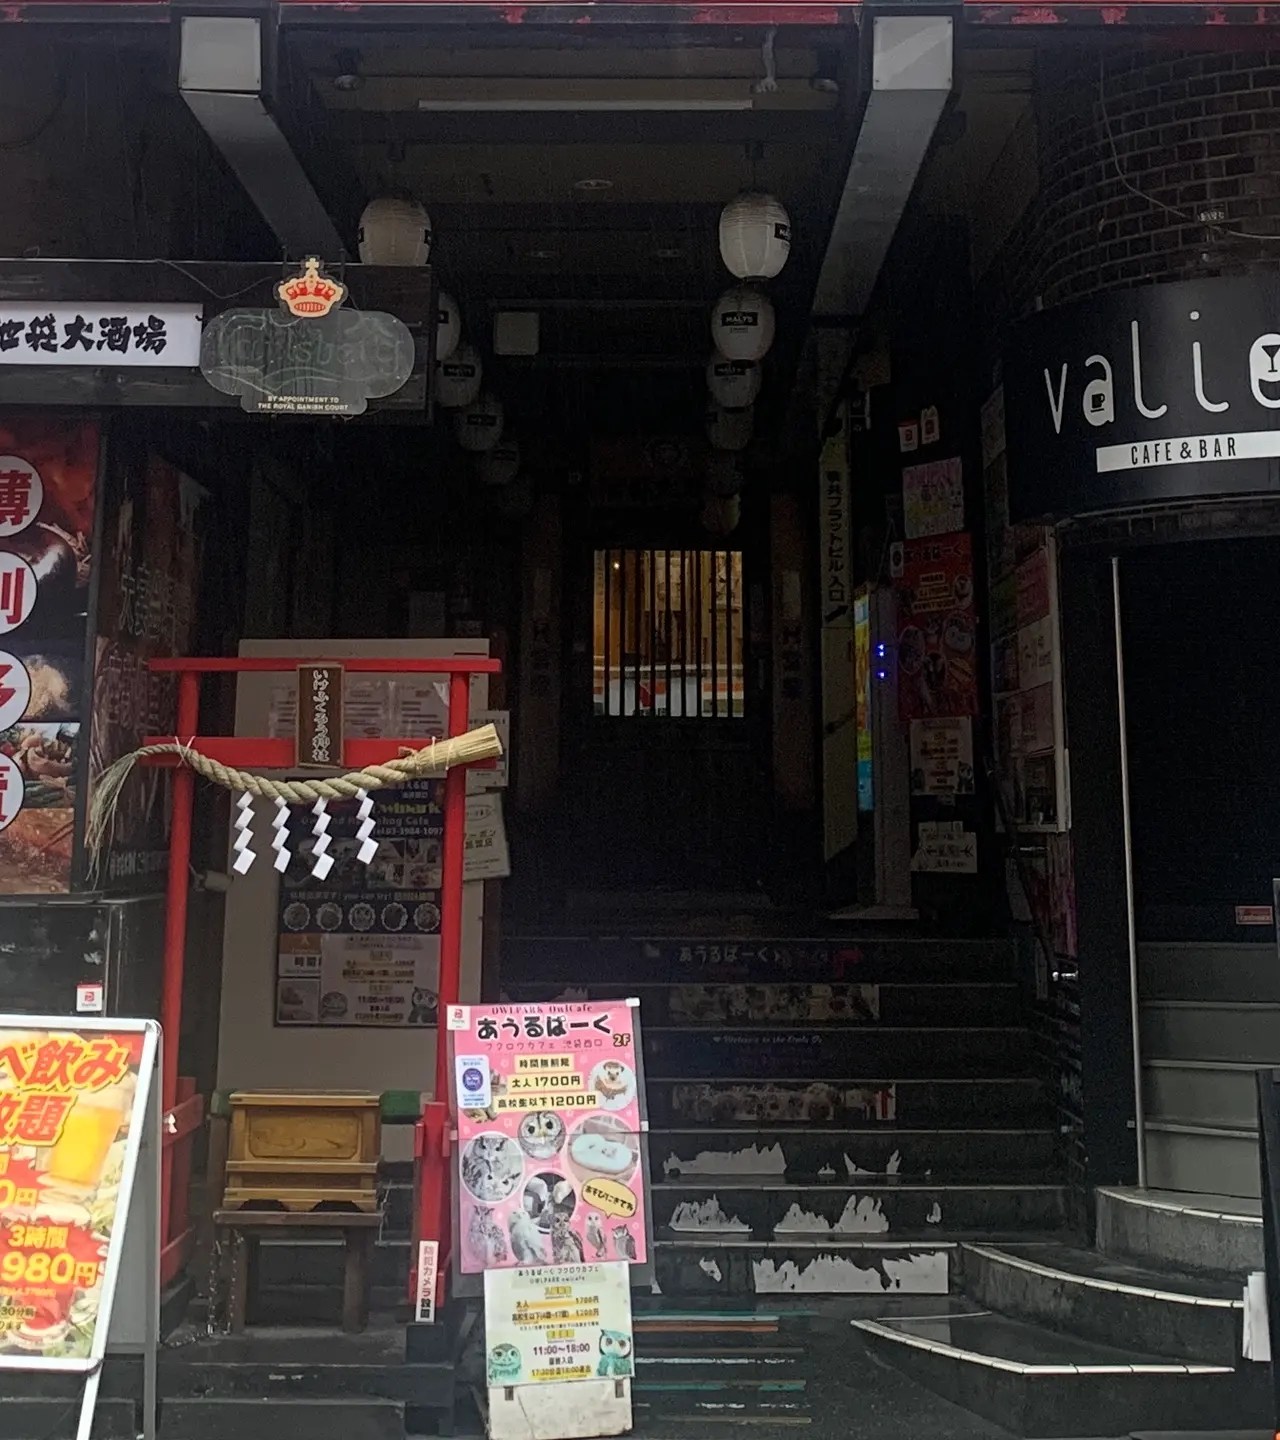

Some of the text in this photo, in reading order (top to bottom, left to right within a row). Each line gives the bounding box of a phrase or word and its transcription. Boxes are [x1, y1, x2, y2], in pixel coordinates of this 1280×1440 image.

[1130, 436, 1238, 465] CAFE & BAR
[476, 1014, 612, 1040] あうるぱーく
[484, 1042, 556, 1052] フクロウカフェ
[613, 1034, 632, 1048] 2F
[8, 1224, 69, 1249] 3時間
